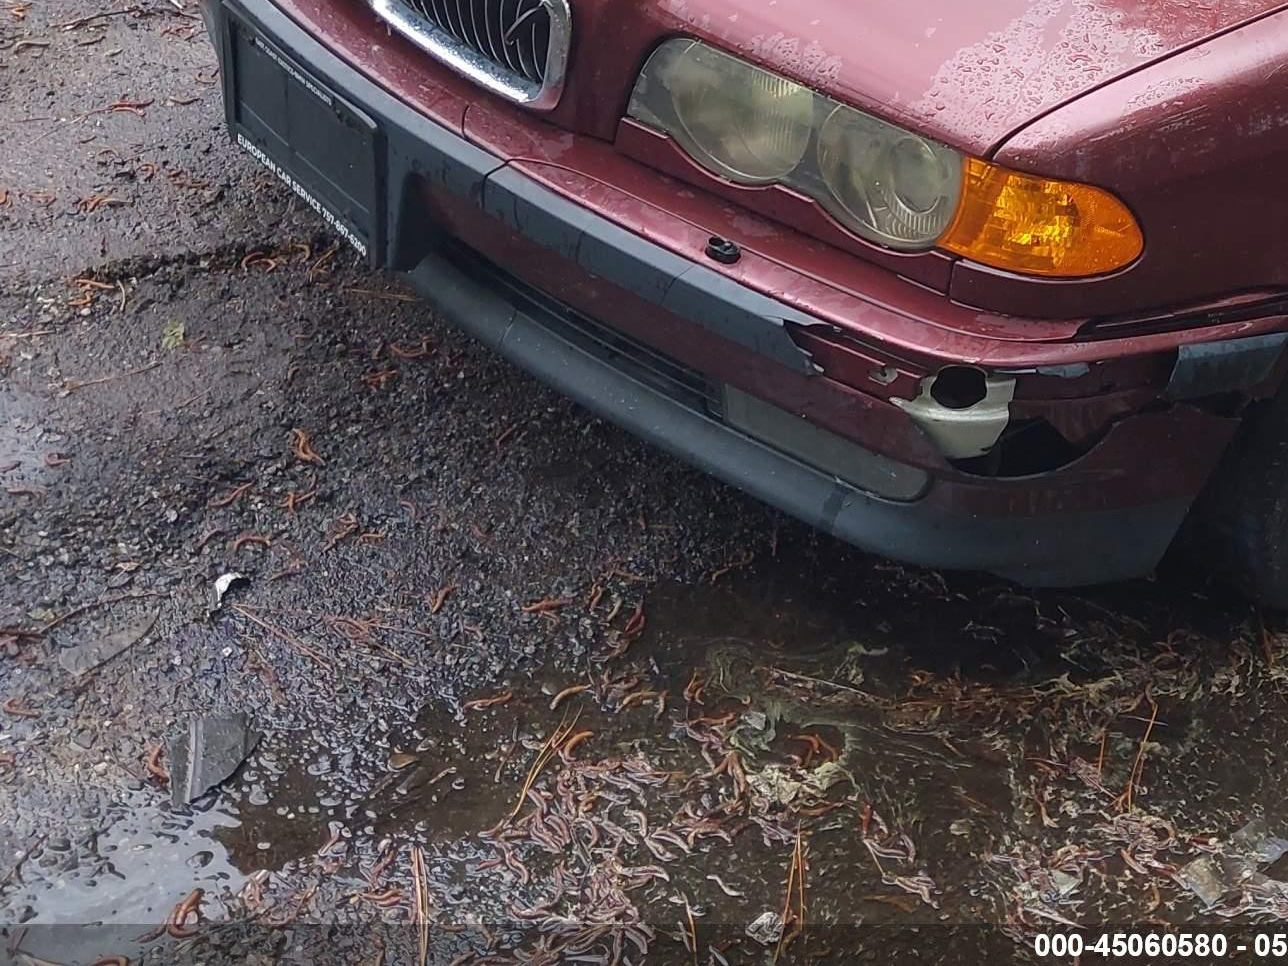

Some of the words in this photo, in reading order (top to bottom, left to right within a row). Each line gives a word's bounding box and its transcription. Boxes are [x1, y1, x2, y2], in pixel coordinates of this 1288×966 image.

[237, 133, 276, 173] EUROPEAN
[276, 166, 292, 187] CAR
[292, 180, 322, 214] SERVICE
